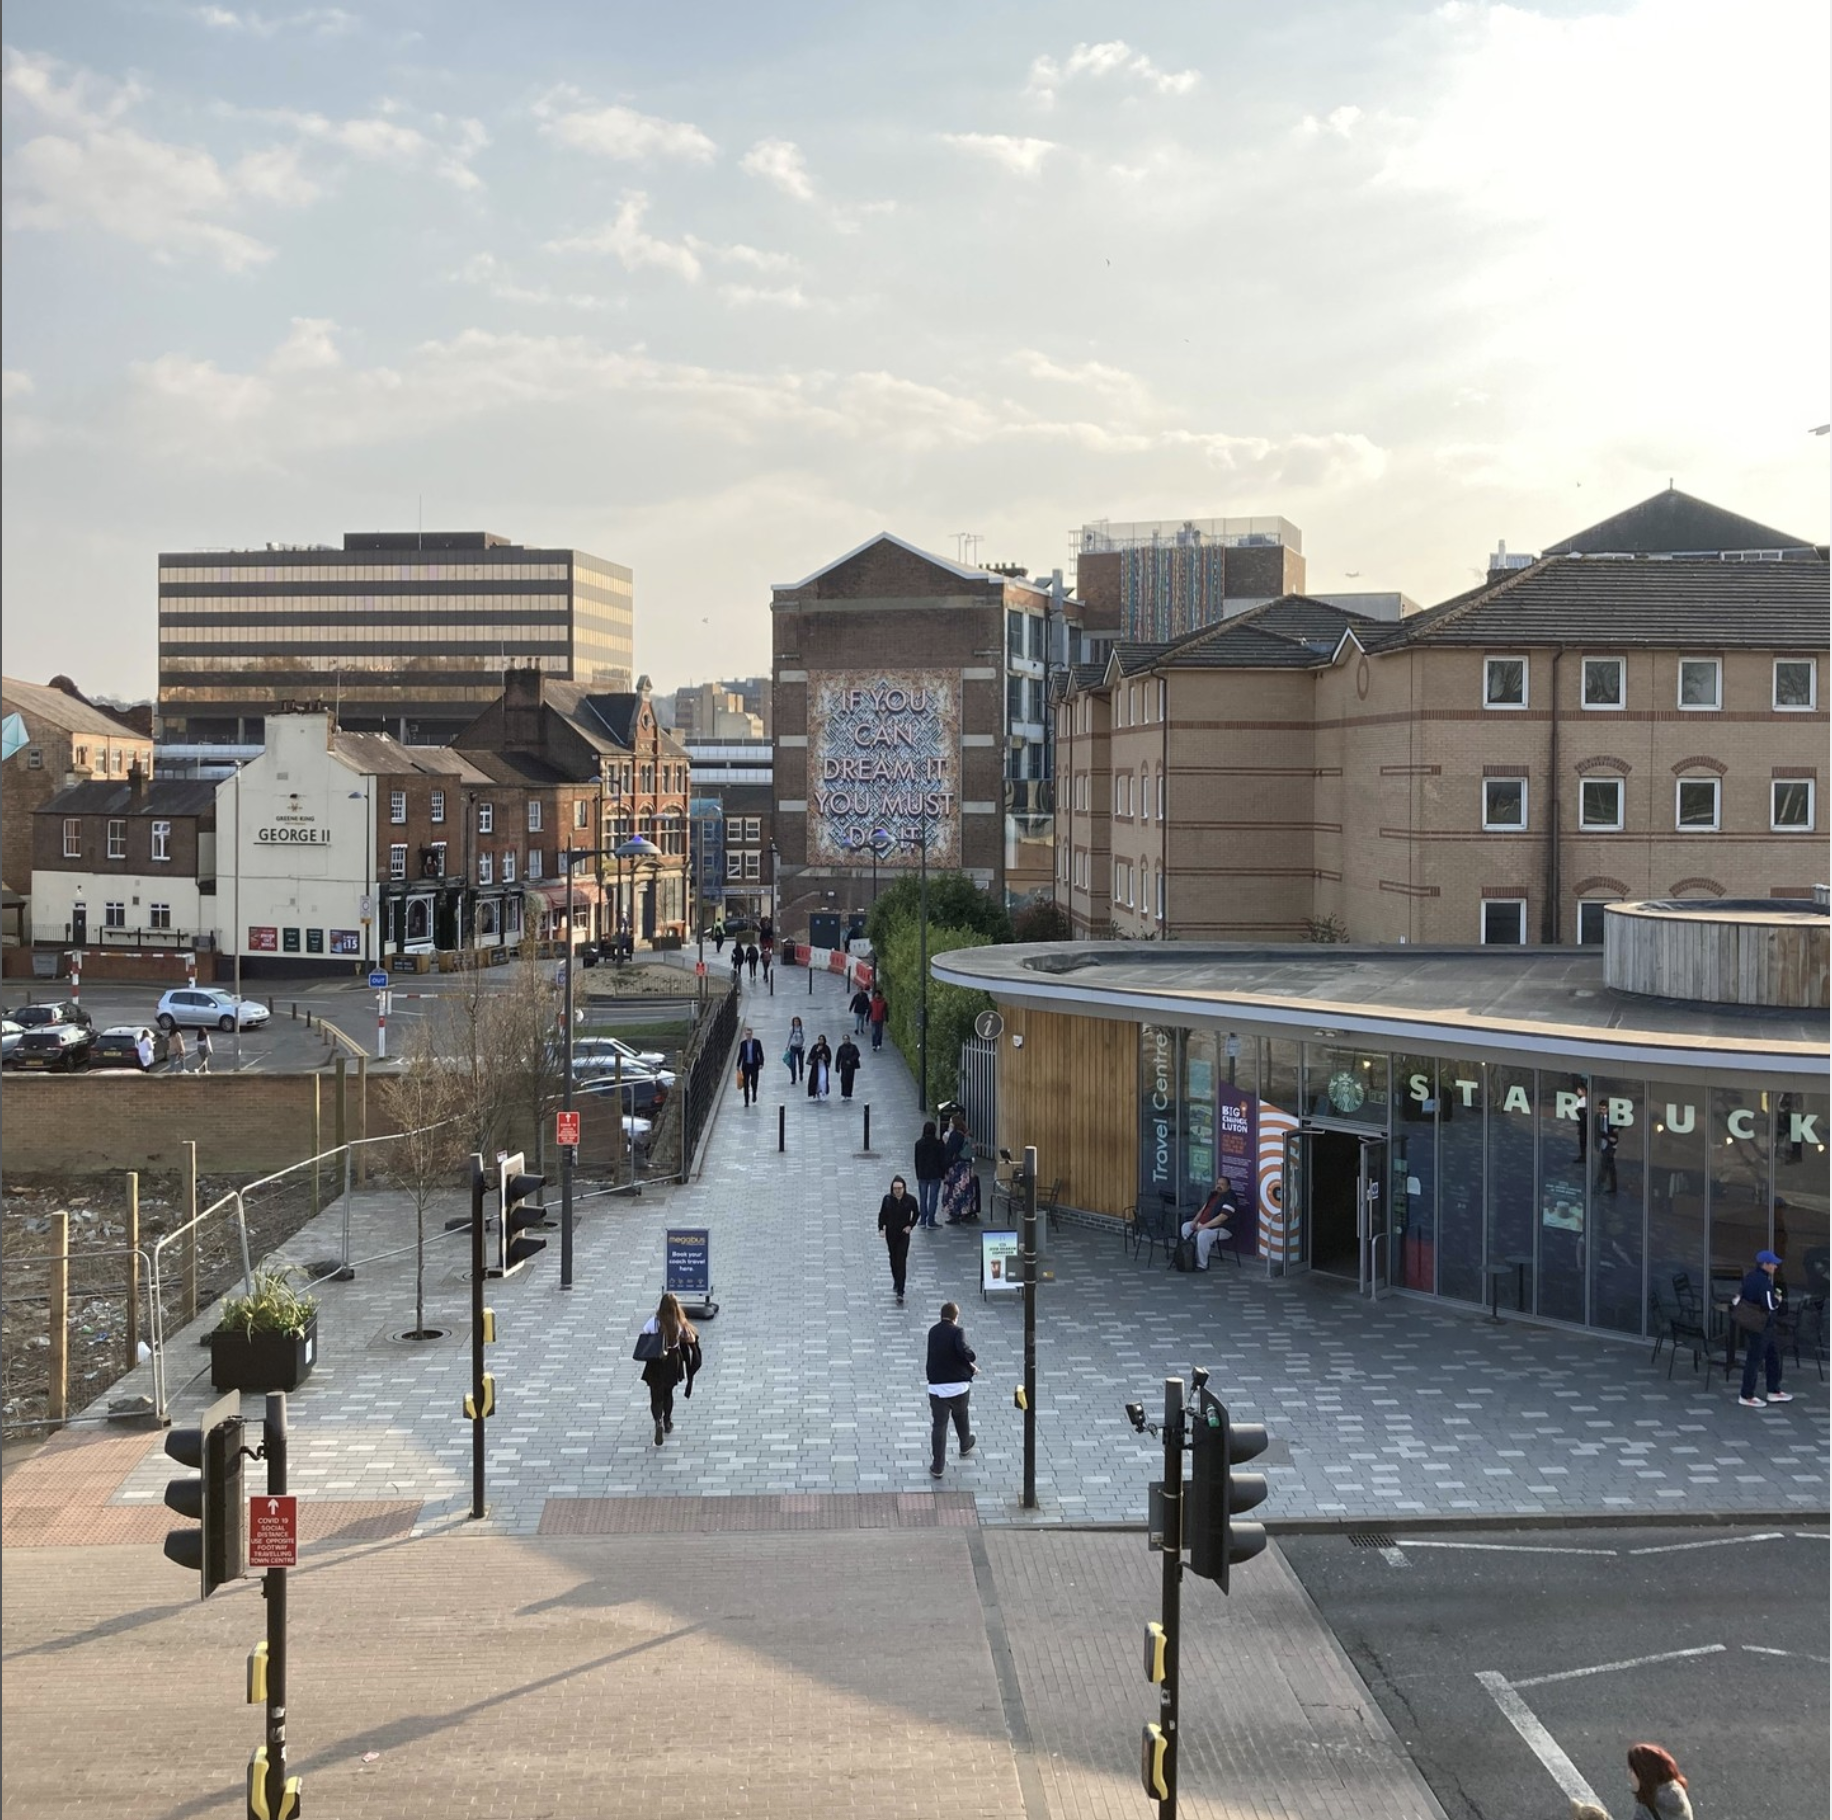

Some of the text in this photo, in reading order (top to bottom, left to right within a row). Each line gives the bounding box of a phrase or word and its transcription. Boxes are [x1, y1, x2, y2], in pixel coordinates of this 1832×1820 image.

[841, 688, 926, 712] IF YOU
[854, 723, 913, 746] CAN
[824, 758, 946, 779] DREAM IT
[815, 791, 954, 815] YOU MUST
[258, 828, 331, 842] GEORGE II
[900, 827, 919, 849] IT
[1153, 1033, 1169, 1183] Travel Centre
[1222, 1105, 1241, 1117] BIG
[1222, 1122, 1248, 1133] LUTON
[669, 1236, 706, 1245] megabus
